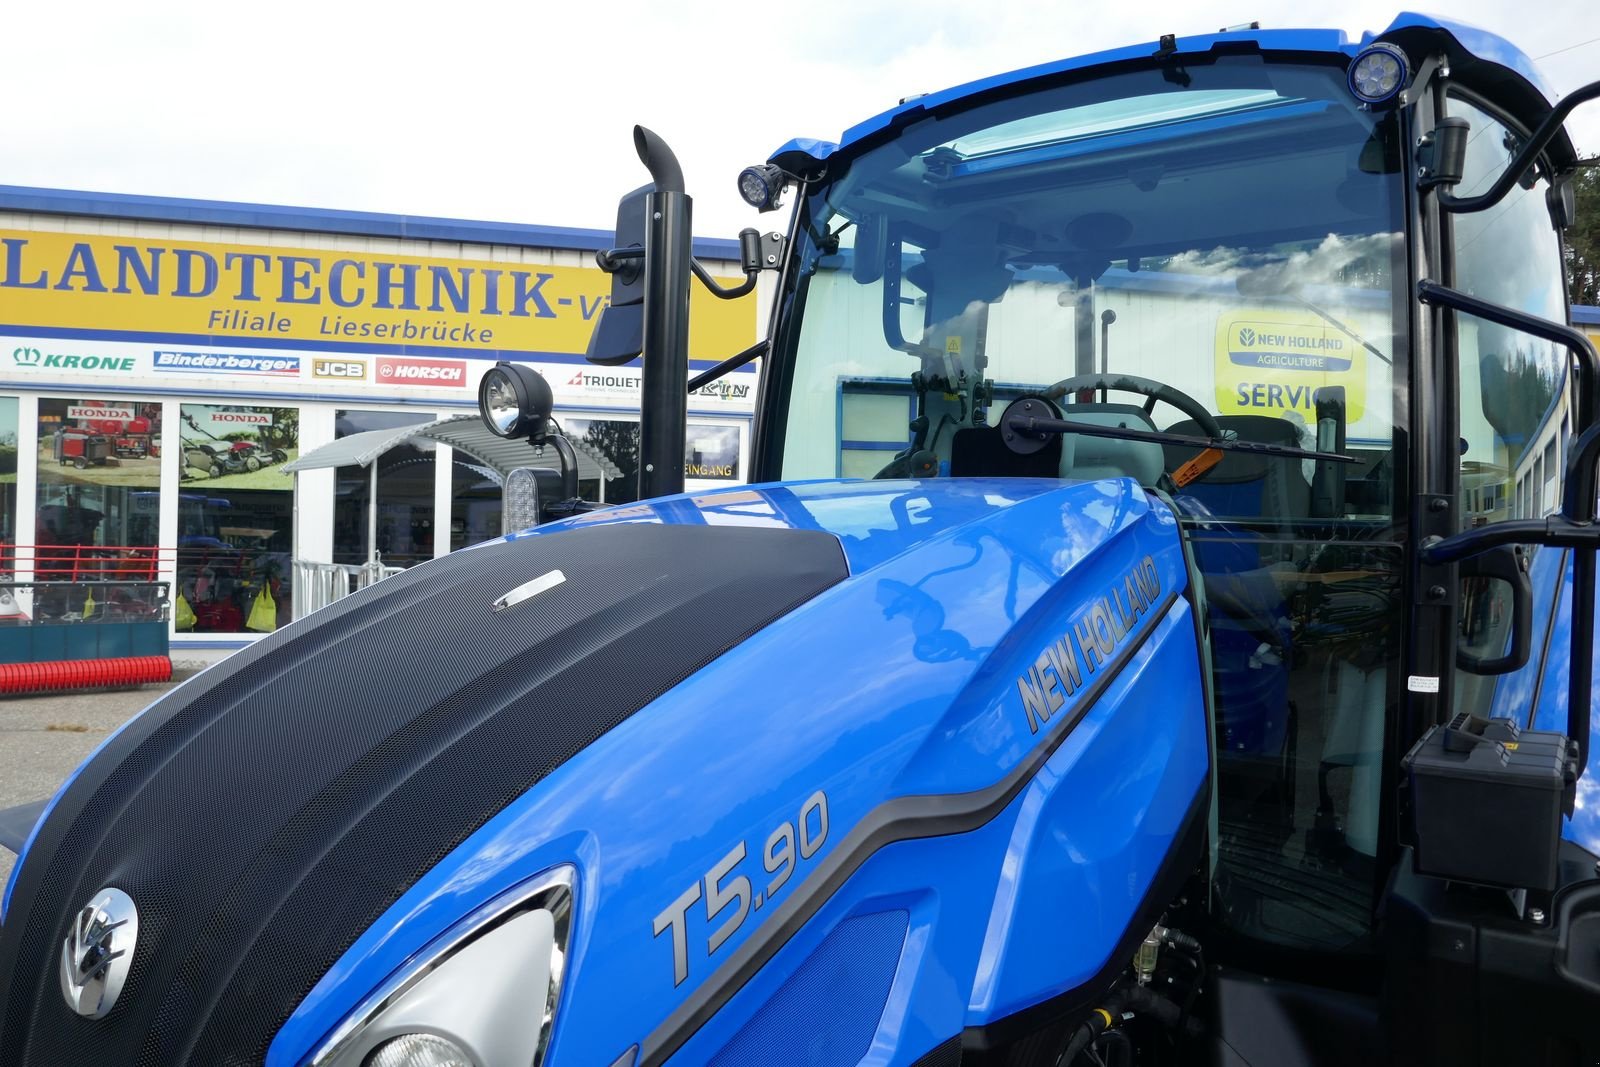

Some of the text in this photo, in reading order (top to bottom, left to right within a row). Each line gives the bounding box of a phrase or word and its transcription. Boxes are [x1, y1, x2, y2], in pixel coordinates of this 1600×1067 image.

[208, 310, 493, 342] Filiale Lieserbrücke
[1258, 334, 1343, 350] NEW HOLLAND
[44, 354, 136, 371] KRONE
[157, 353, 297, 372] Binderberger
[1257, 355, 1324, 367] AGRICULTURE
[315, 362, 364, 378] JCB
[395, 366, 462, 380] HORSCH
[583, 376, 642, 388] TRIOLIET
[71, 408, 131, 419] HONDA
[211, 413, 270, 424] HONDA
[684, 463, 732, 477] EINGANG
[1017, 554, 1161, 735] NEW HOLLAND
[652, 789, 829, 990] T5.90
